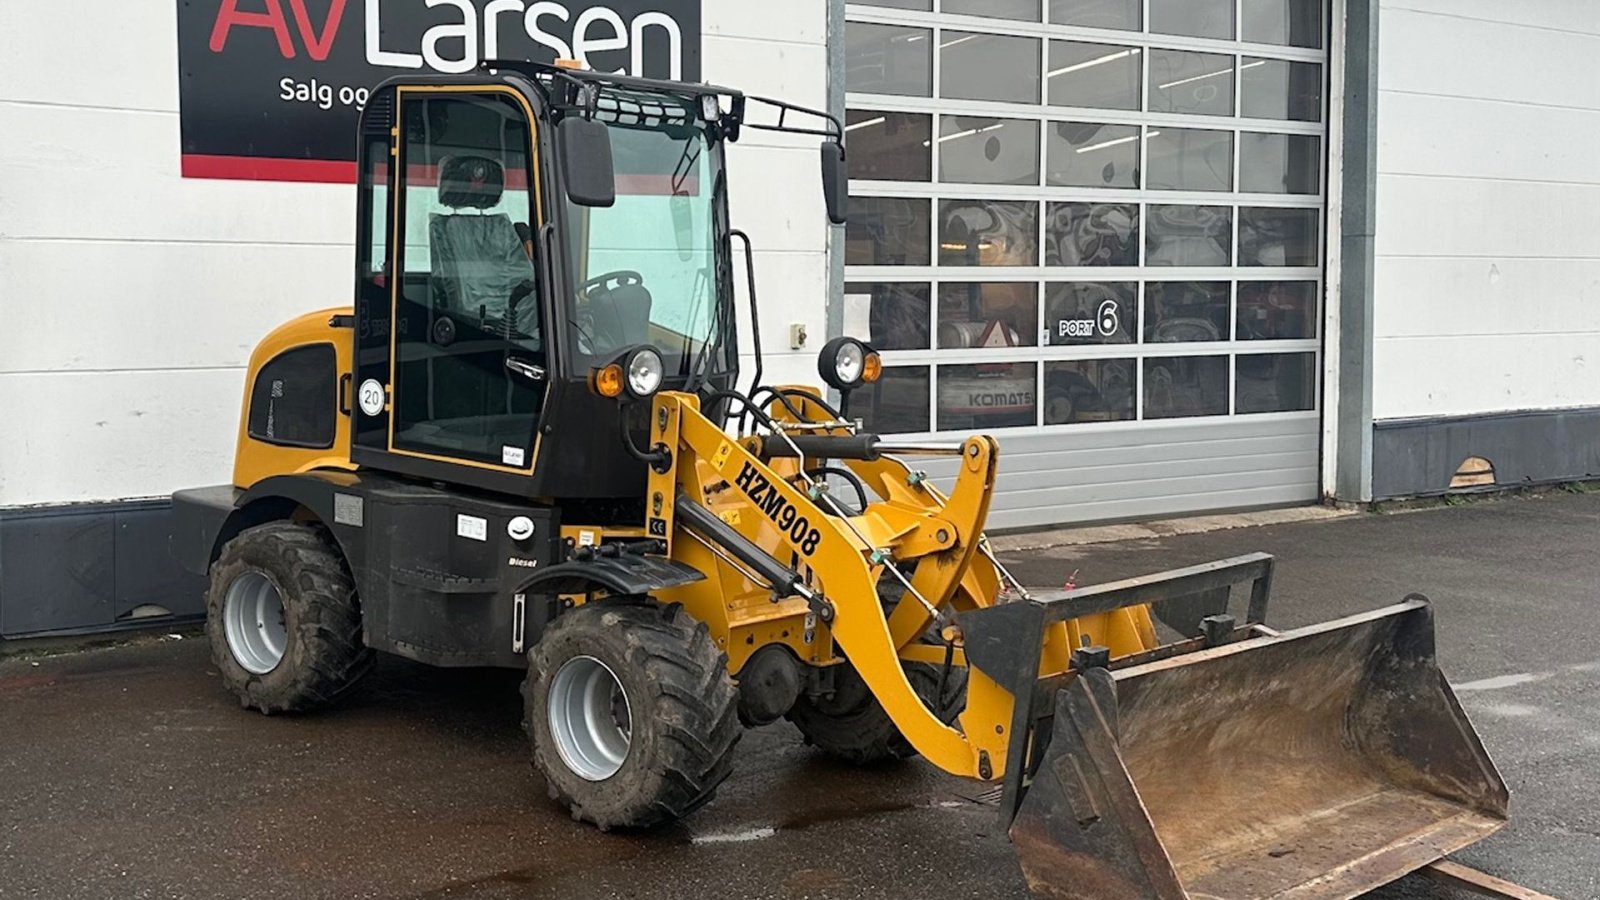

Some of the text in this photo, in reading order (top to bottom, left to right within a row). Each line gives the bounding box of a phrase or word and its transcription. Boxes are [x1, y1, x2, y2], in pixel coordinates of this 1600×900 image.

[280, 78, 369, 111] Salg og
[1059, 299, 1118, 336] PORT 6
[365, 389, 379, 406] 20
[969, 392, 1034, 406] KOMATS
[735, 460, 821, 556] HZM908
[508, 557, 537, 568] Diesel
